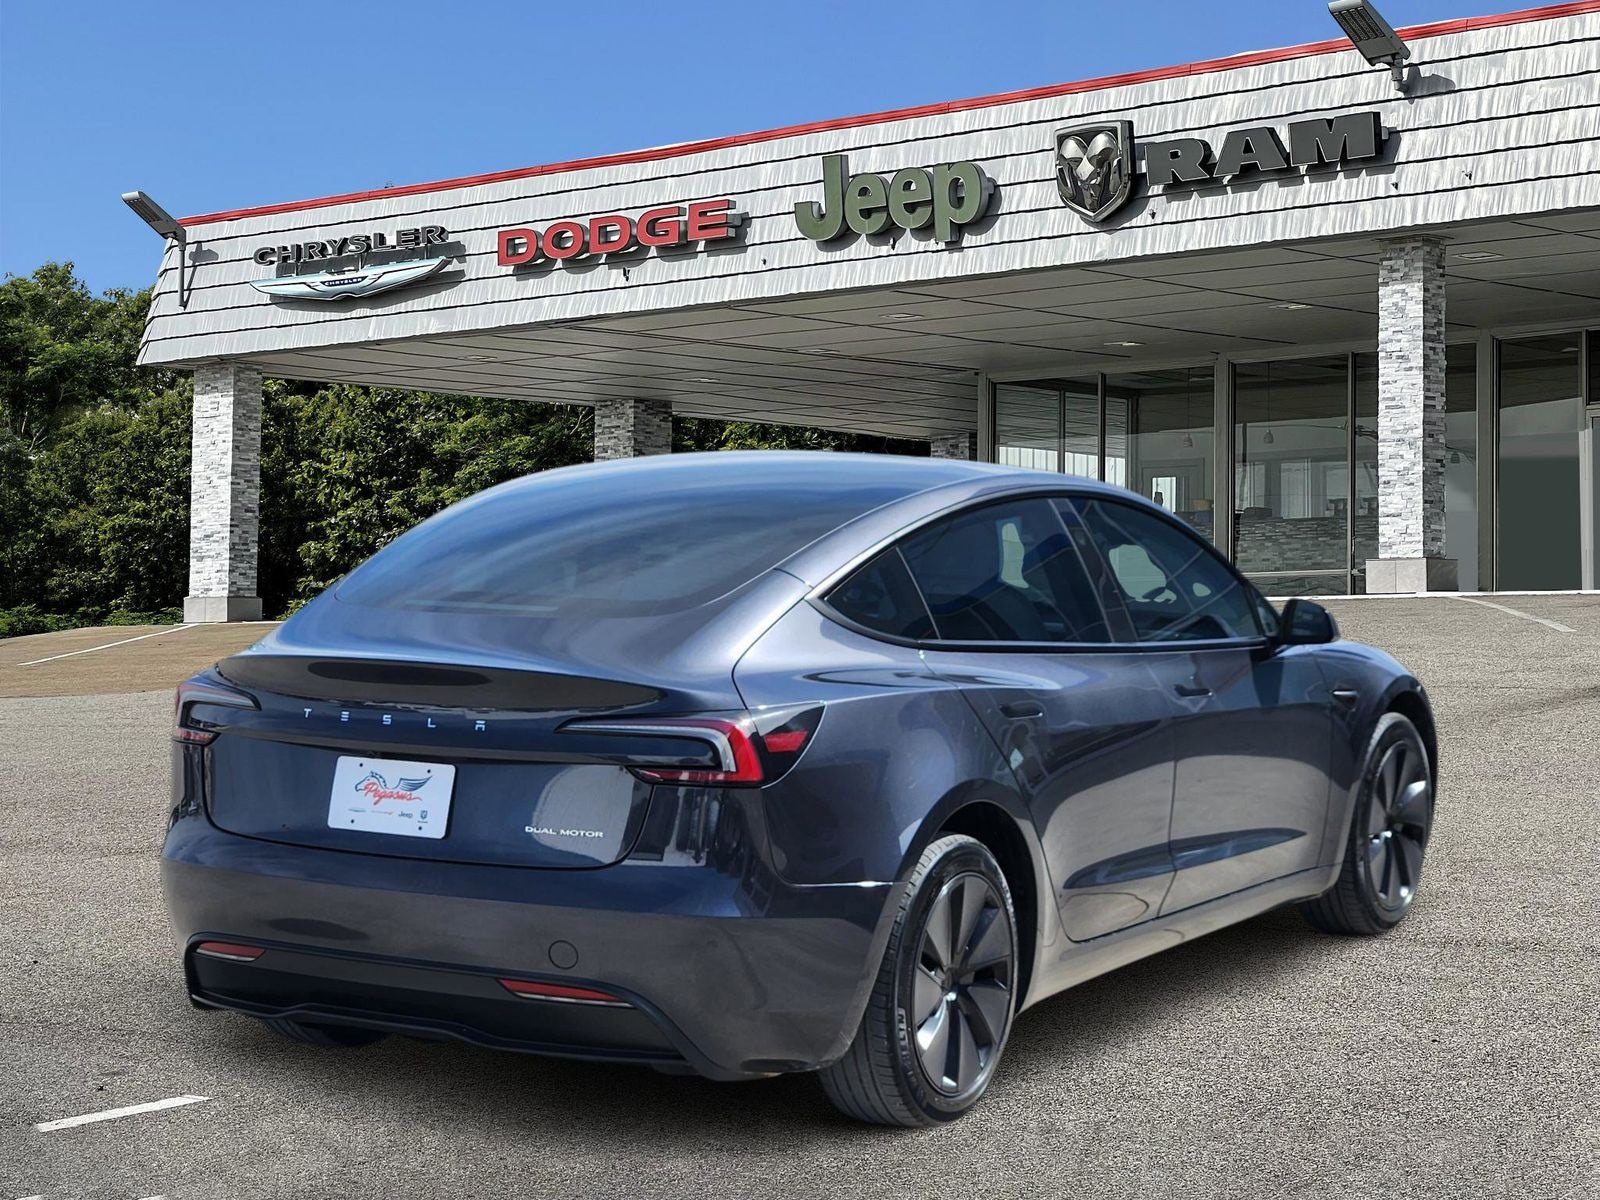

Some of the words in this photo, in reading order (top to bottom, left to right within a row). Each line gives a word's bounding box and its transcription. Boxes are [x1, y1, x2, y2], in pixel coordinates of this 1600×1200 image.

[1145, 112, 1378, 186] RAM
[795, 155, 987, 243] Jeep
[497, 199, 734, 266] DODGE
[253, 225, 447, 266] CHRYSLER
[324, 277, 364, 287] CHRYSLER
[304, 708, 485, 731] TESLA
[364, 781, 422, 805] Pegasus
[398, 810, 414, 819] Jeep
[525, 826, 557, 835] DUAL
[560, 829, 604, 838] MOTOR
